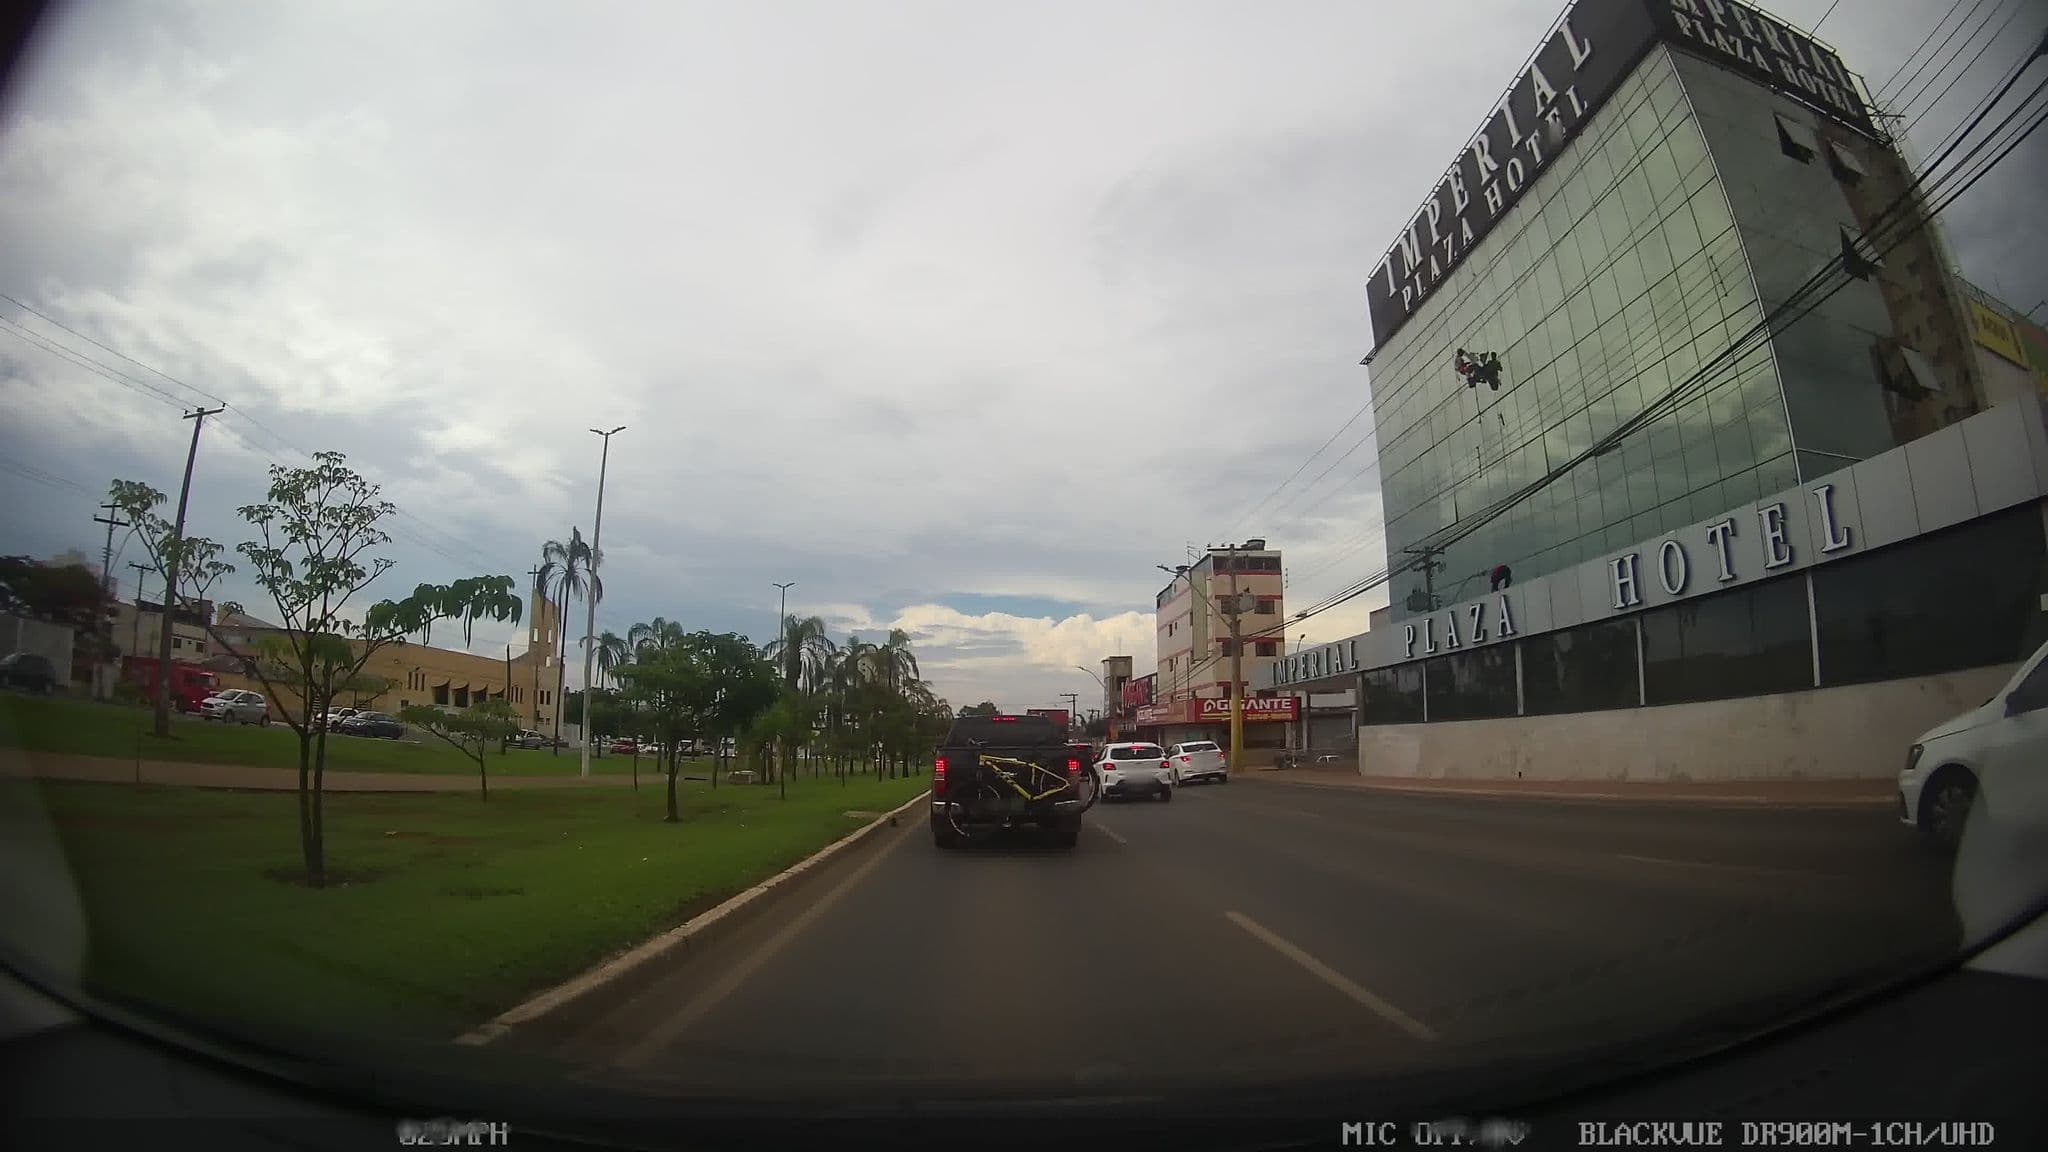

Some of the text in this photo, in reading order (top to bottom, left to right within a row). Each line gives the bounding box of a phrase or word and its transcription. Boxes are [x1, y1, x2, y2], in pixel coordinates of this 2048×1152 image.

[1670, 0, 1856, 93] PERIAL
[1671, 10, 1859, 118] PLAZA HOTEL
[1383, 17, 1592, 298] IMPERIAL
[1401, 85, 1590, 313] PLAZA HOTEL
[1272, 484, 1852, 686] IMPERIAL PLAZA HOTEL
